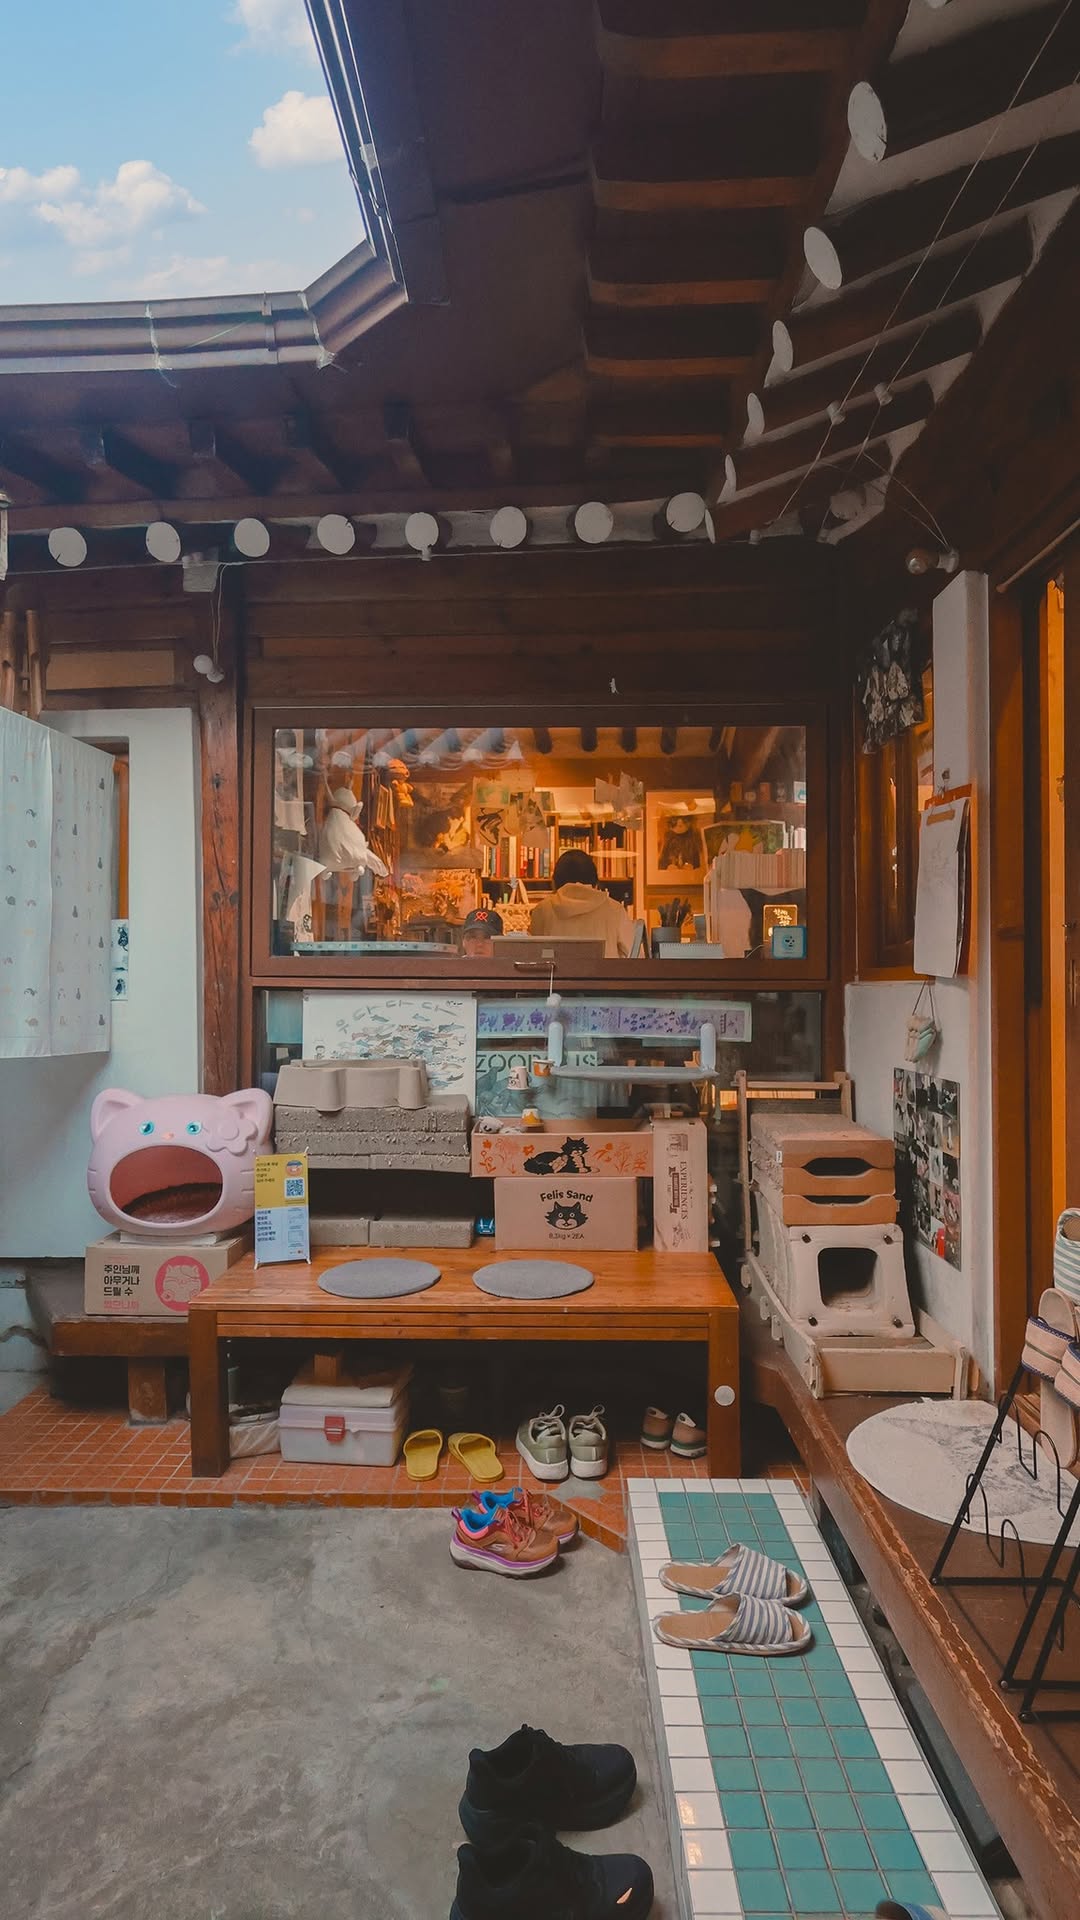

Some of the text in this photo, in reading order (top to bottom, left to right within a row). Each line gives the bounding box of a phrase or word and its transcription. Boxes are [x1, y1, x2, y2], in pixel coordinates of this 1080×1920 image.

[476, 1054, 598, 1073] ZOOPIS
[540, 1189, 593, 1202] Felis Sand
[680, 1161, 689, 1220] EXPERIENCES
[104, 1264, 140, 1274] 주인님께
[104, 1275, 140, 1285] 아무거나
[124, 1287, 134, 1296] 수
